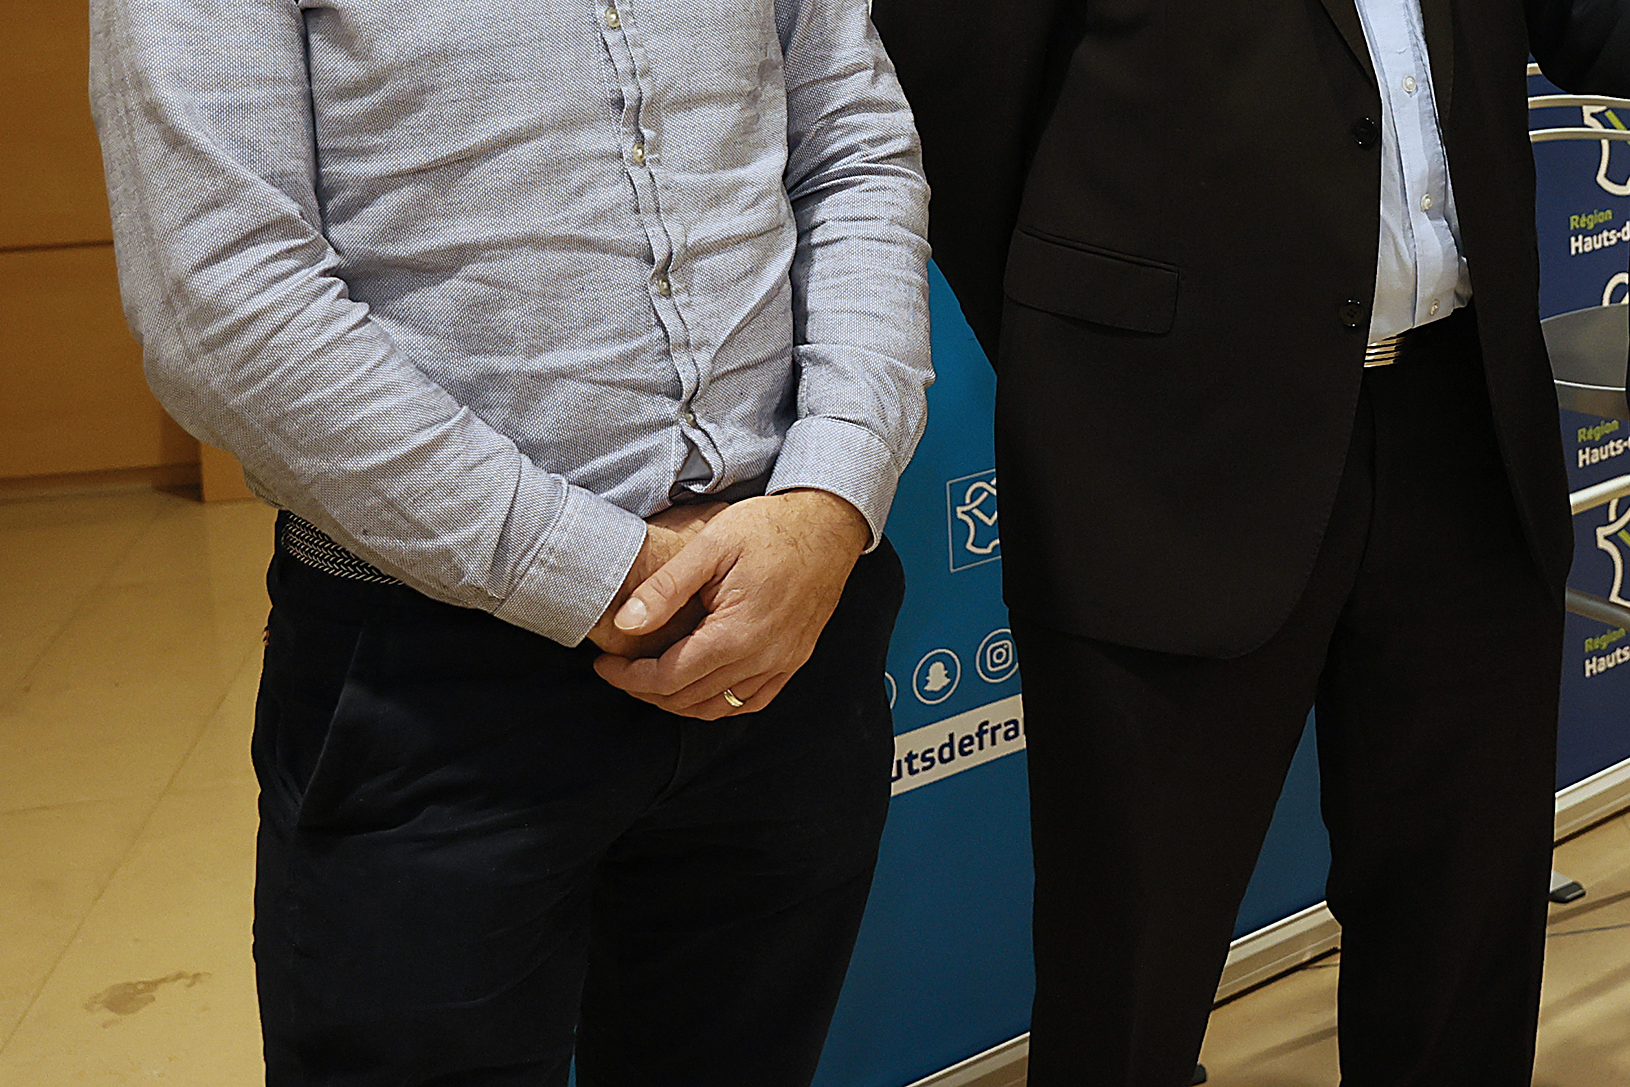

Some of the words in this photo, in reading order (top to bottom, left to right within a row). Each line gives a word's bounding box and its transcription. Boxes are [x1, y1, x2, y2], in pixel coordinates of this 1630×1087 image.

[1569, 209, 1613, 231] Région
[1577, 419, 1620, 443] Région
[891, 718, 1020, 783] utsdefra
